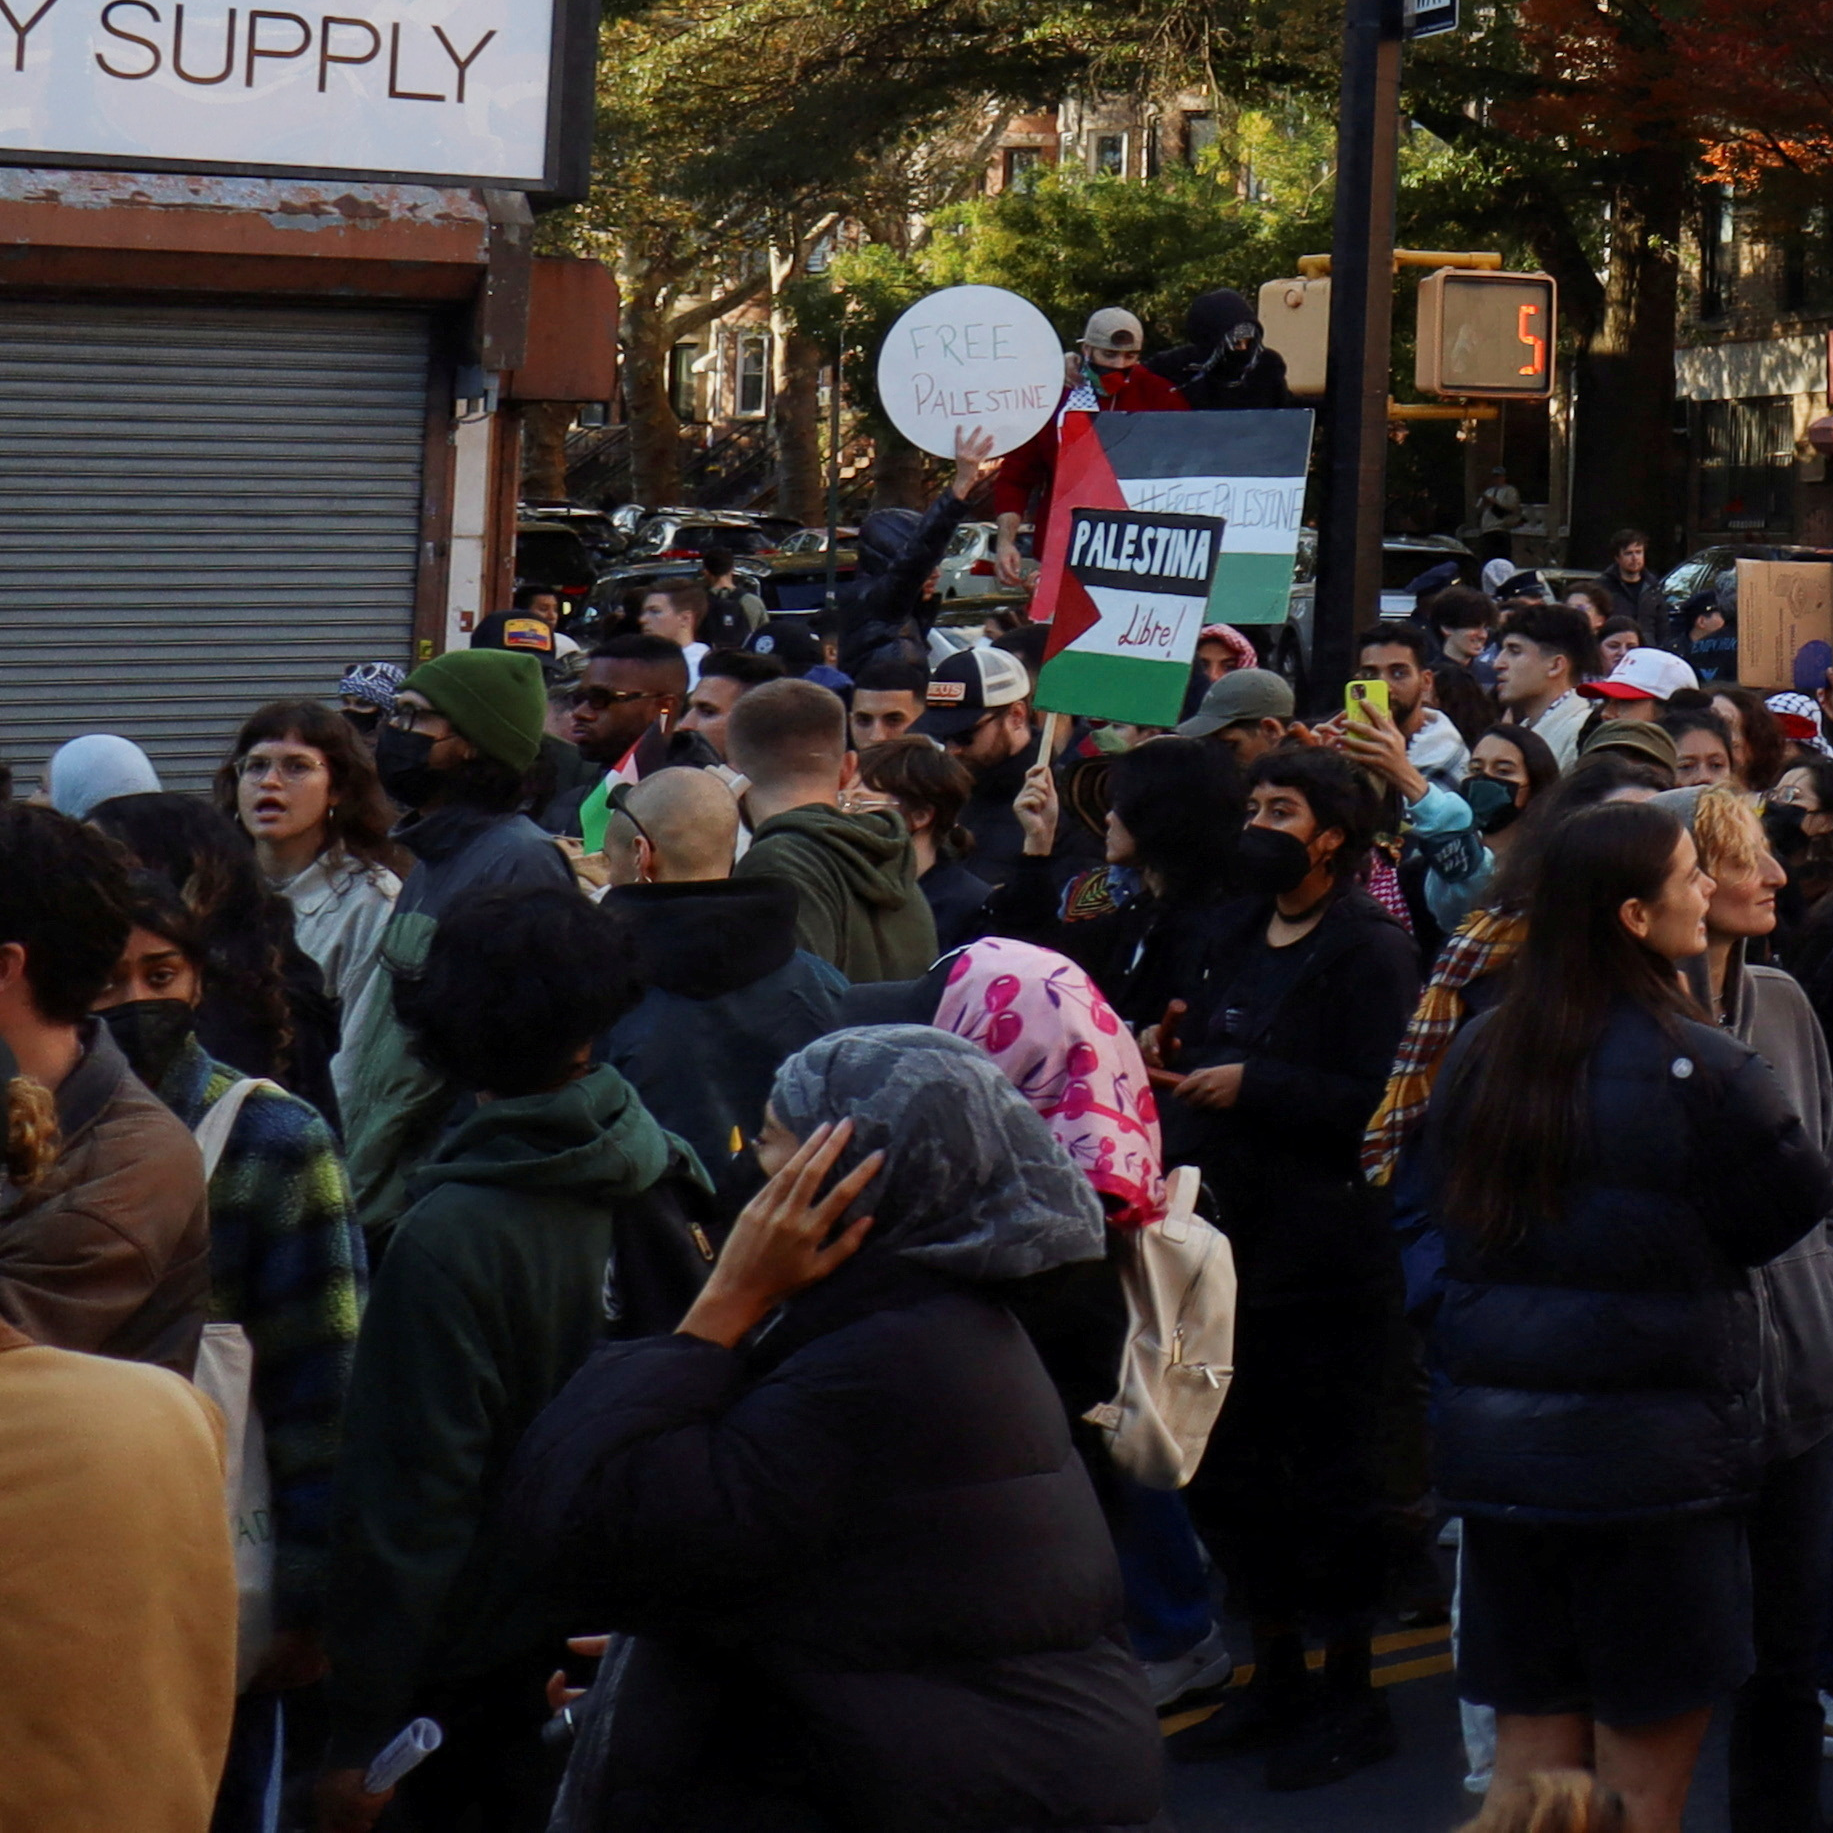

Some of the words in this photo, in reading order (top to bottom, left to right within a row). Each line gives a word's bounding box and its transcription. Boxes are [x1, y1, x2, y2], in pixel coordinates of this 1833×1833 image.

[910, 323, 1019, 366] FREE
[1519, 303, 1546, 376] 5
[911, 373, 1051, 419] PALESTINE
[1070, 519, 1213, 582] PALESTINA
[1117, 602, 1188, 659] Libre!
